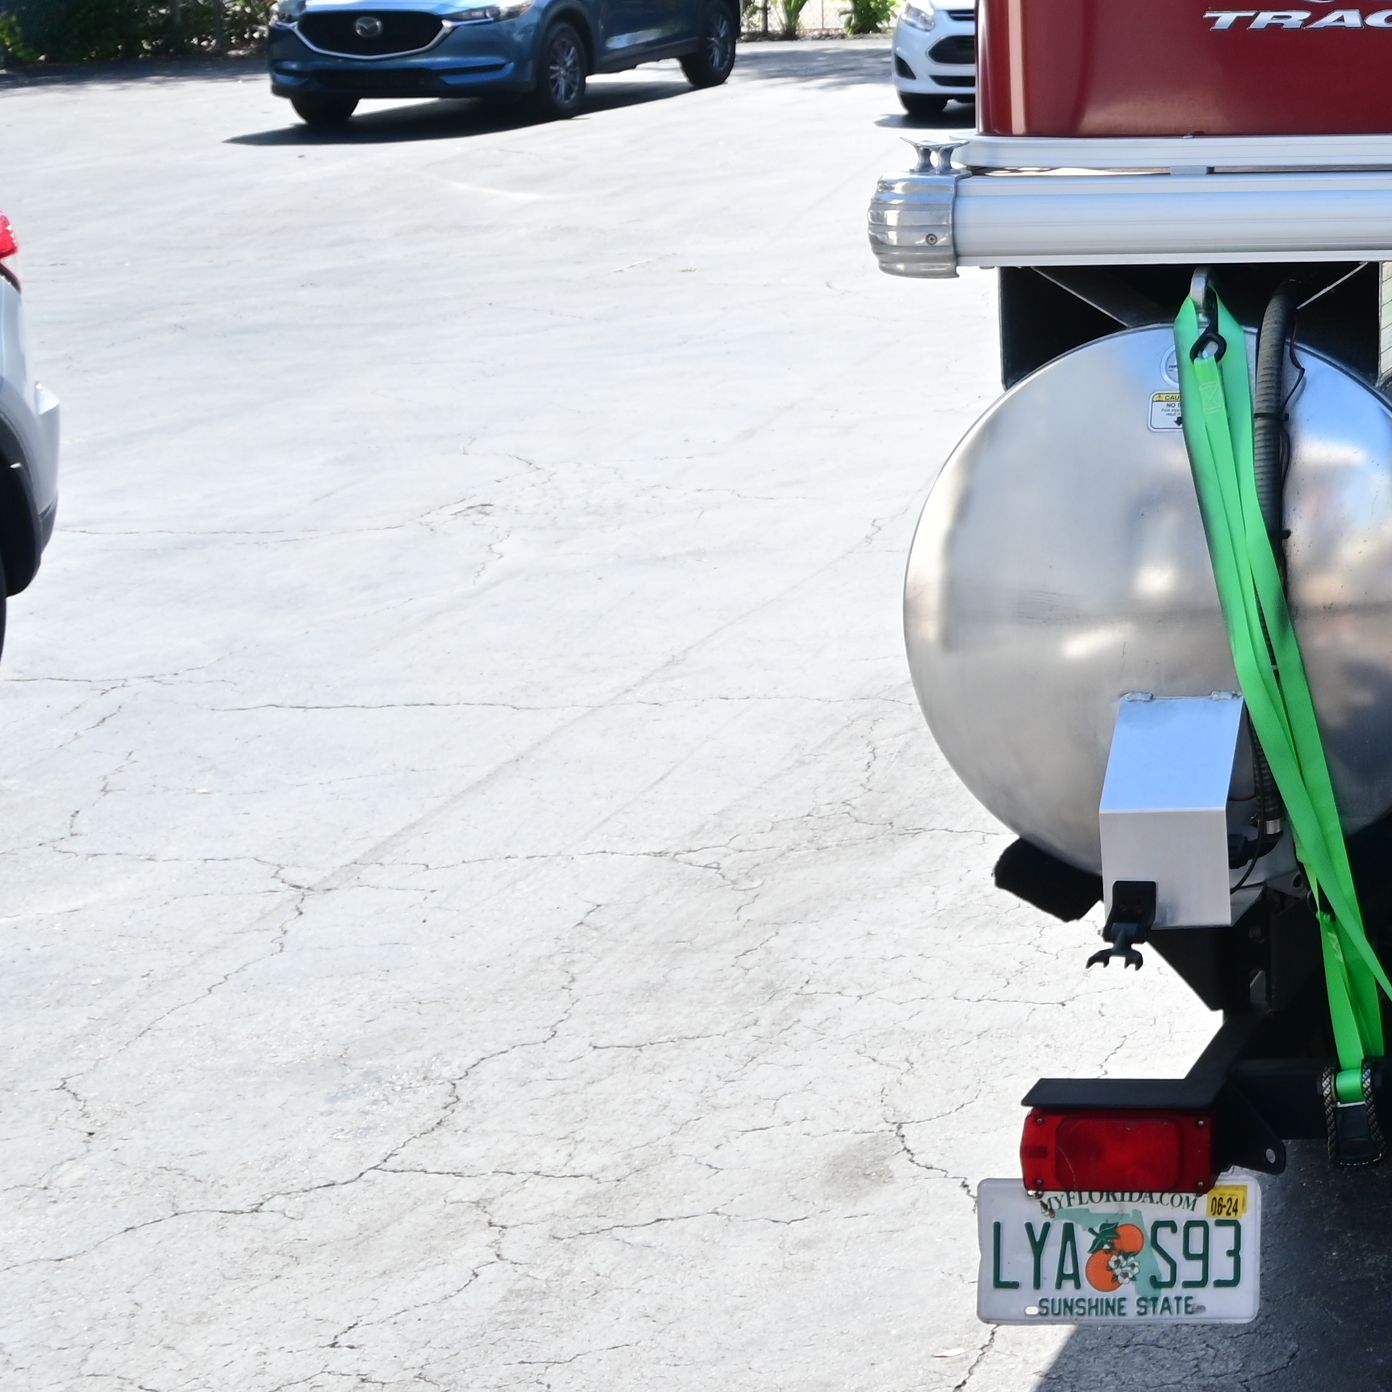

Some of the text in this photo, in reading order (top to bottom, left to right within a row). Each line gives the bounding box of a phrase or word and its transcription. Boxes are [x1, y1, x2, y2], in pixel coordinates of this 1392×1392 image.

[1211, 1196, 1239, 1217] 06-24
[993, 1219, 1242, 1290] LYA S93
[1038, 1296, 1194, 1316] SUNSHINE STATE
